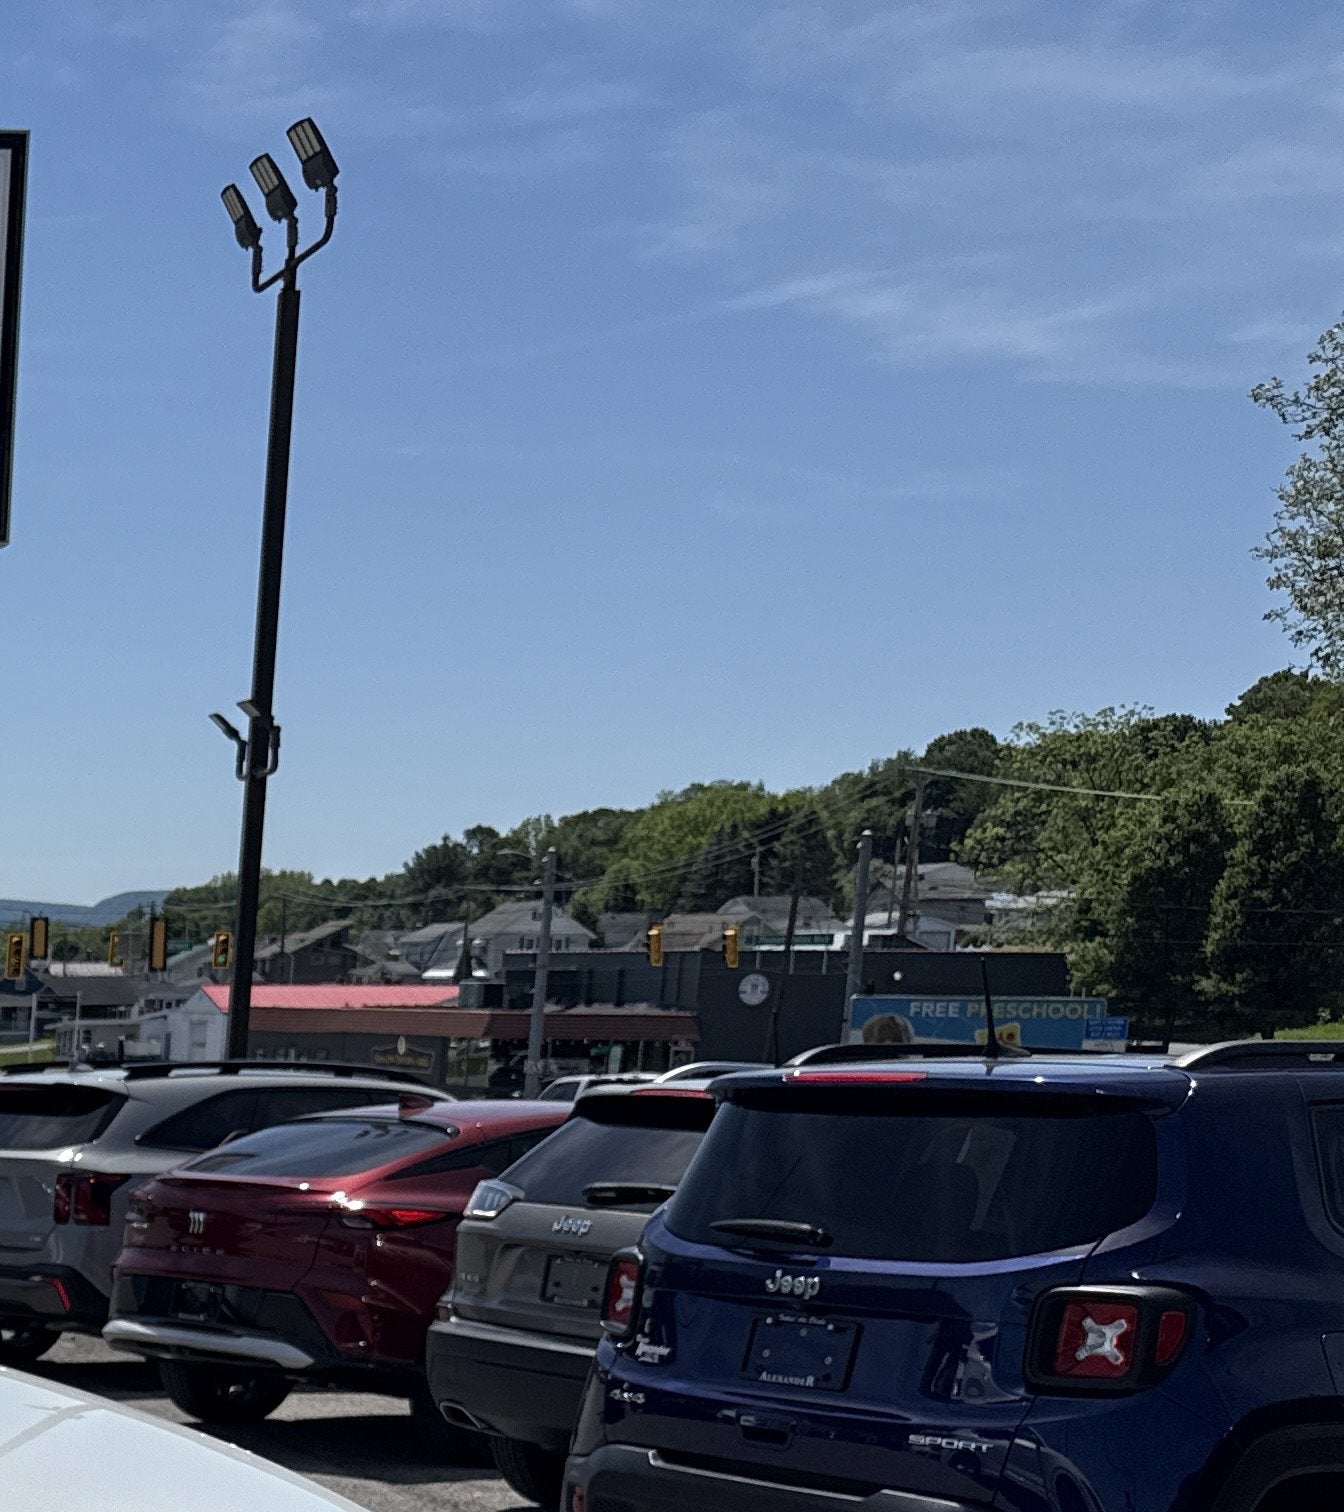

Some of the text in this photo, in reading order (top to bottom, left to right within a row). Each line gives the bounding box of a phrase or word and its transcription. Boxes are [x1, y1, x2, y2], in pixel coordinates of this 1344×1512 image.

[910, 1001, 960, 1018] FREE
[552, 1215, 592, 1237] Jeep
[765, 1269, 820, 1300] Jeep
[908, 1434, 994, 1453] SPORT
